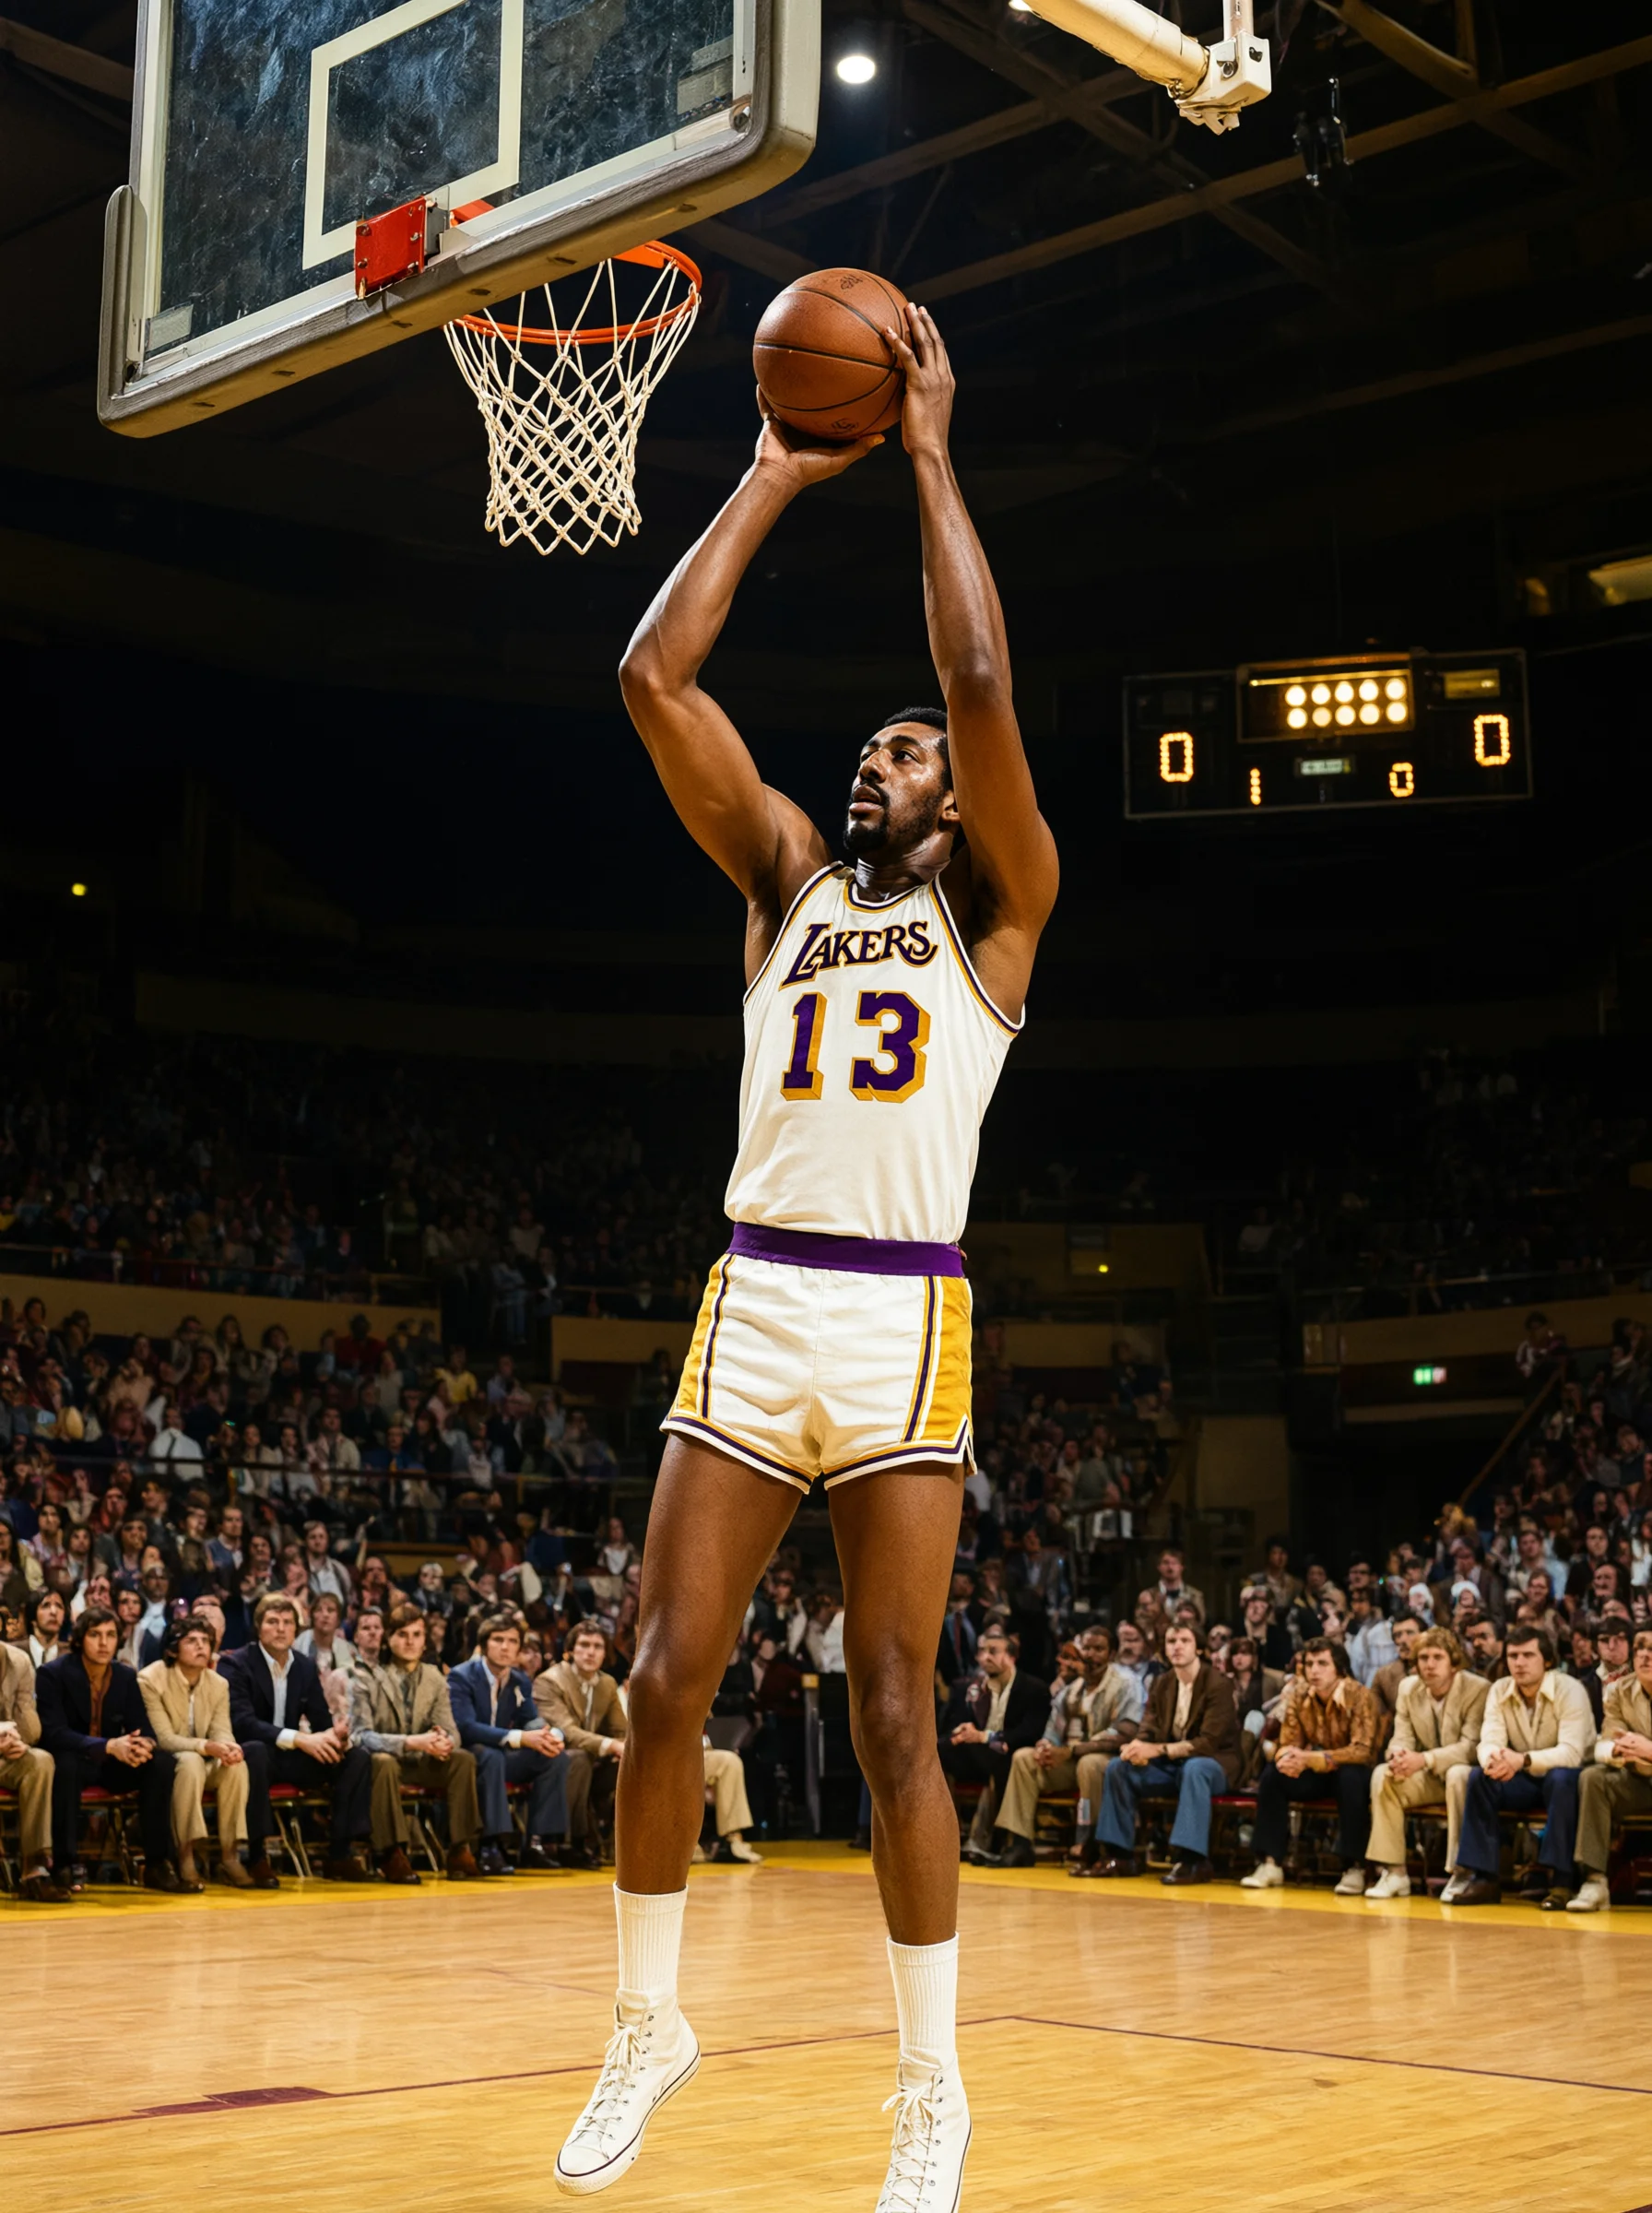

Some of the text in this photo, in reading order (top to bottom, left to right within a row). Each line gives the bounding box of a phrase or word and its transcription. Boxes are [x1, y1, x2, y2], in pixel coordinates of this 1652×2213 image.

[1160, 732, 1194, 782] 0
[1473, 714, 1511, 767] 0
[1249, 768, 1261, 805] 1
[1388, 763, 1414, 798] 0
[778, 920, 940, 992] LAKERS
[780, 989, 931, 1104] 13
